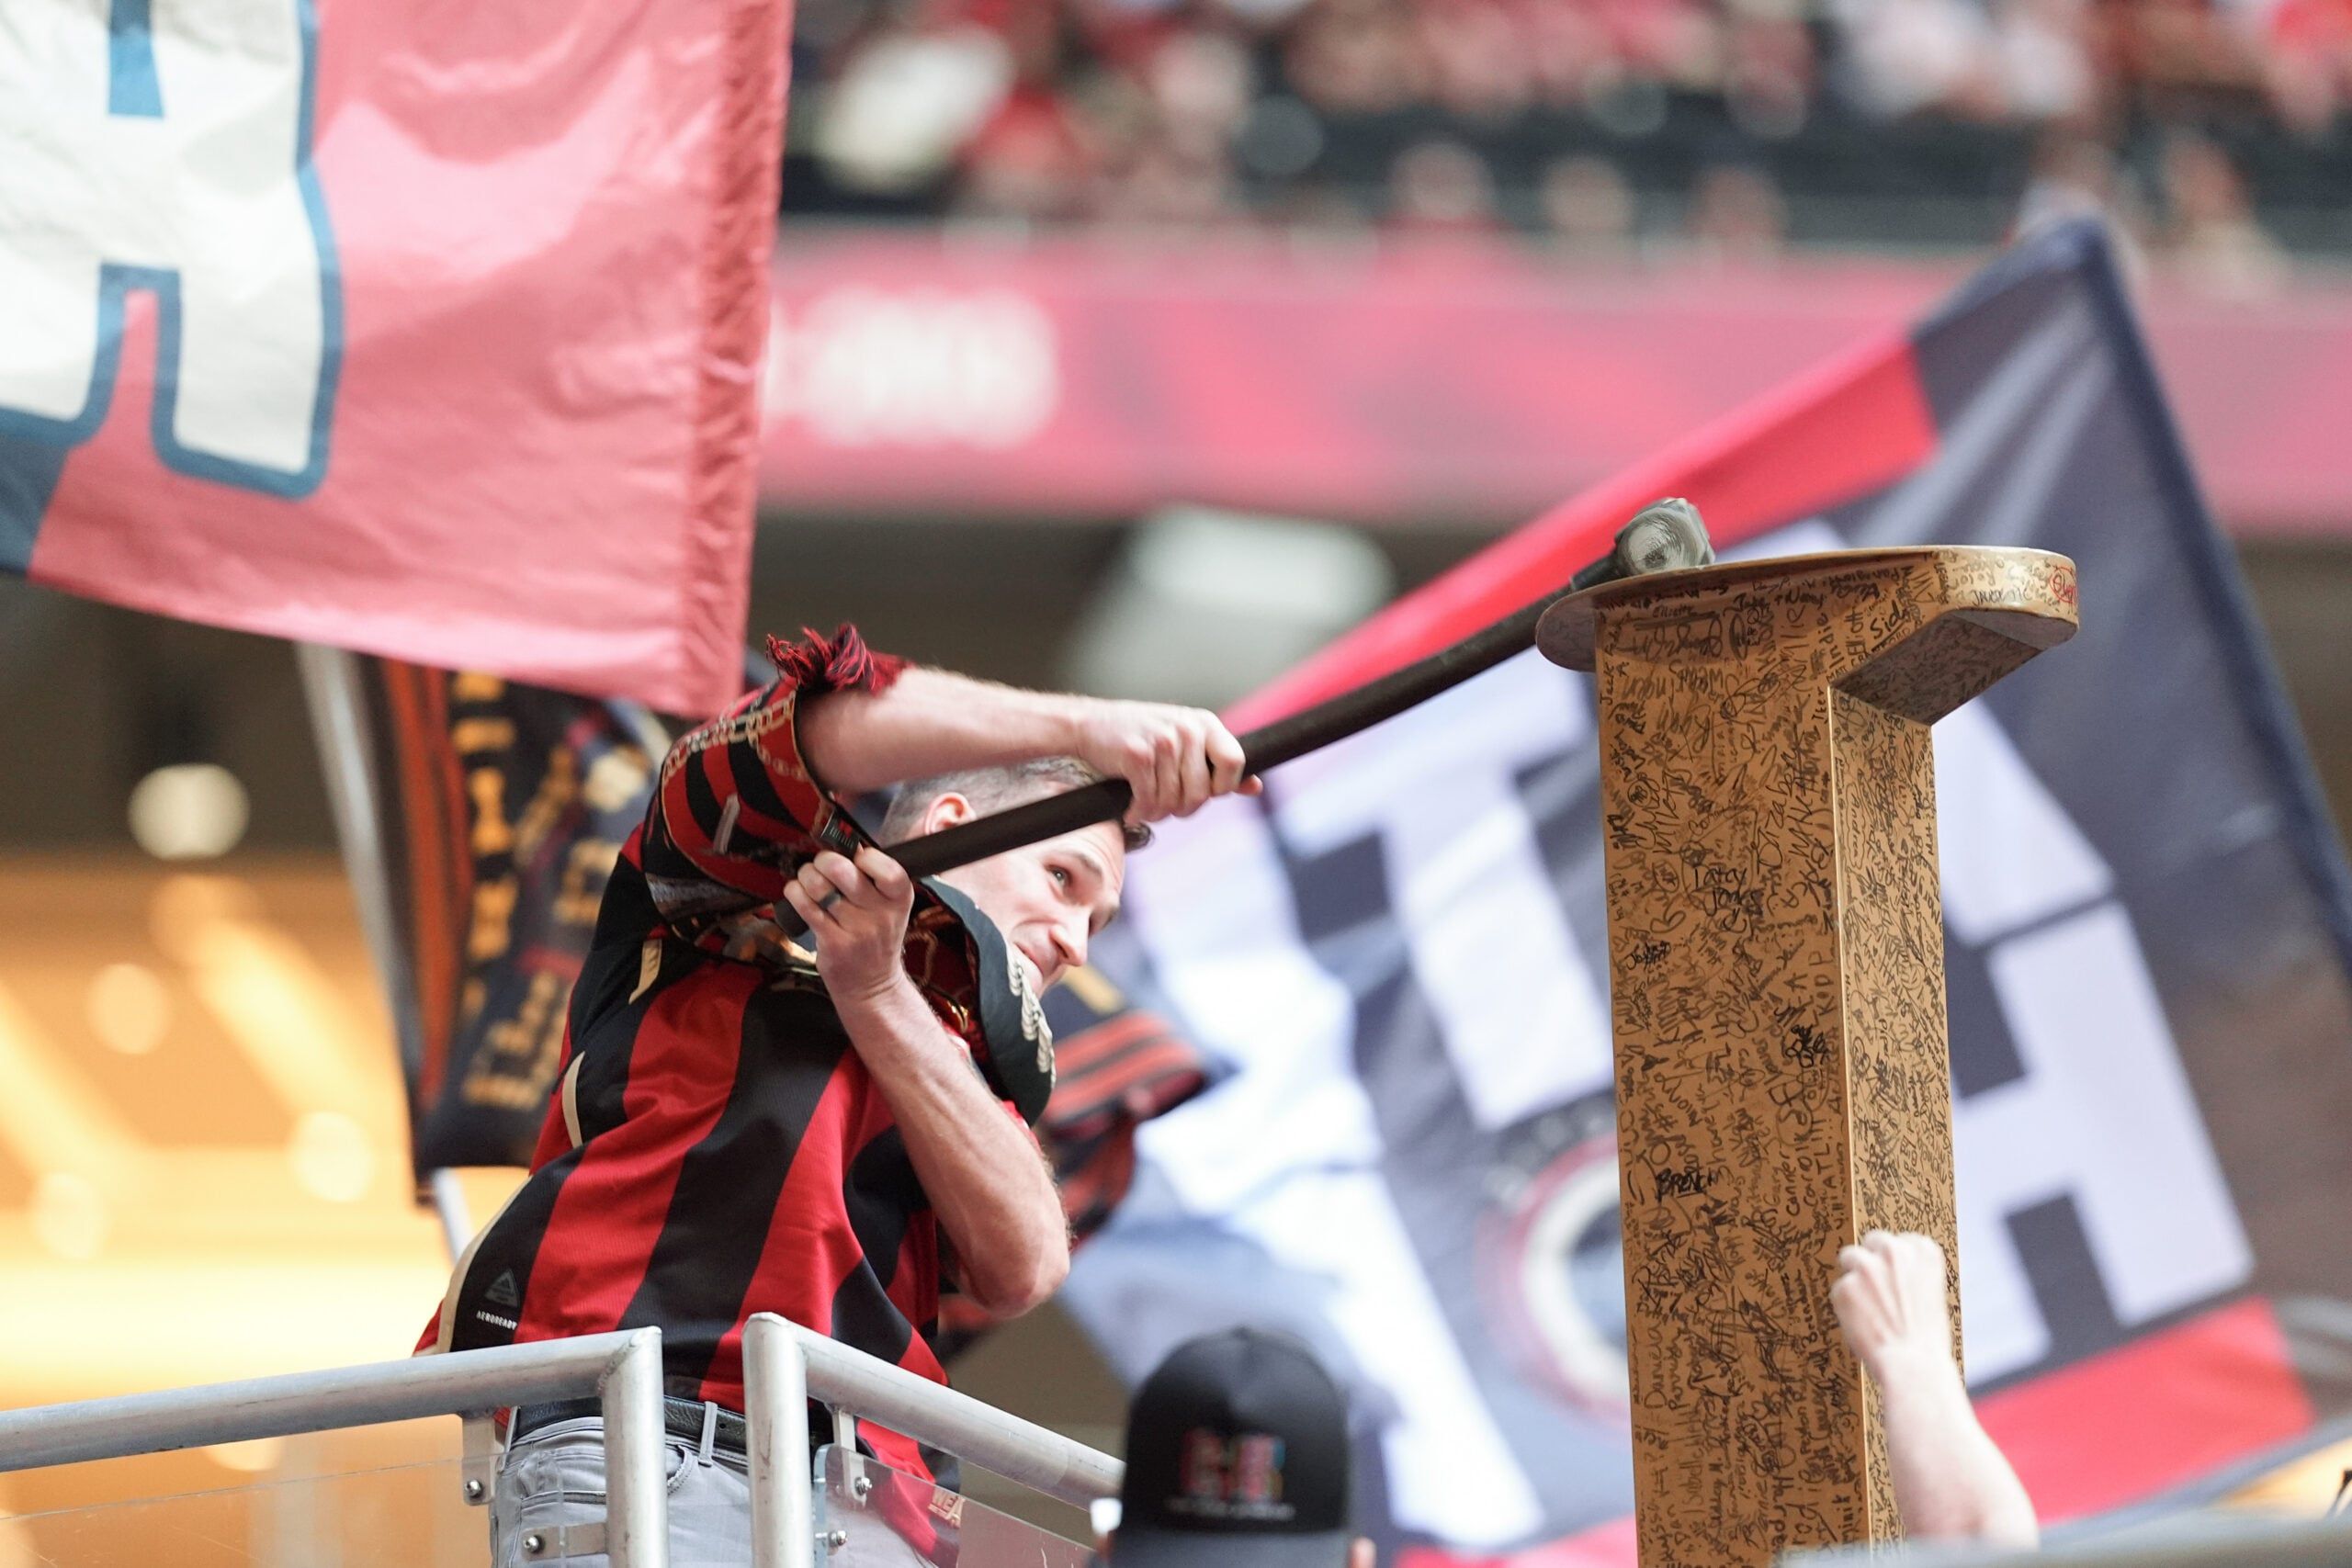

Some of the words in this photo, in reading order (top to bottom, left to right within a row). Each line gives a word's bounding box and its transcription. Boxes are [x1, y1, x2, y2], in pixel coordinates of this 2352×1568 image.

[1816, 613, 1844, 669] Indie
[1850, 793, 1861, 858] Andrea
[476, 1310, 517, 1331] AEROREADY
[1643, 1321, 1668, 1410] Daniela
